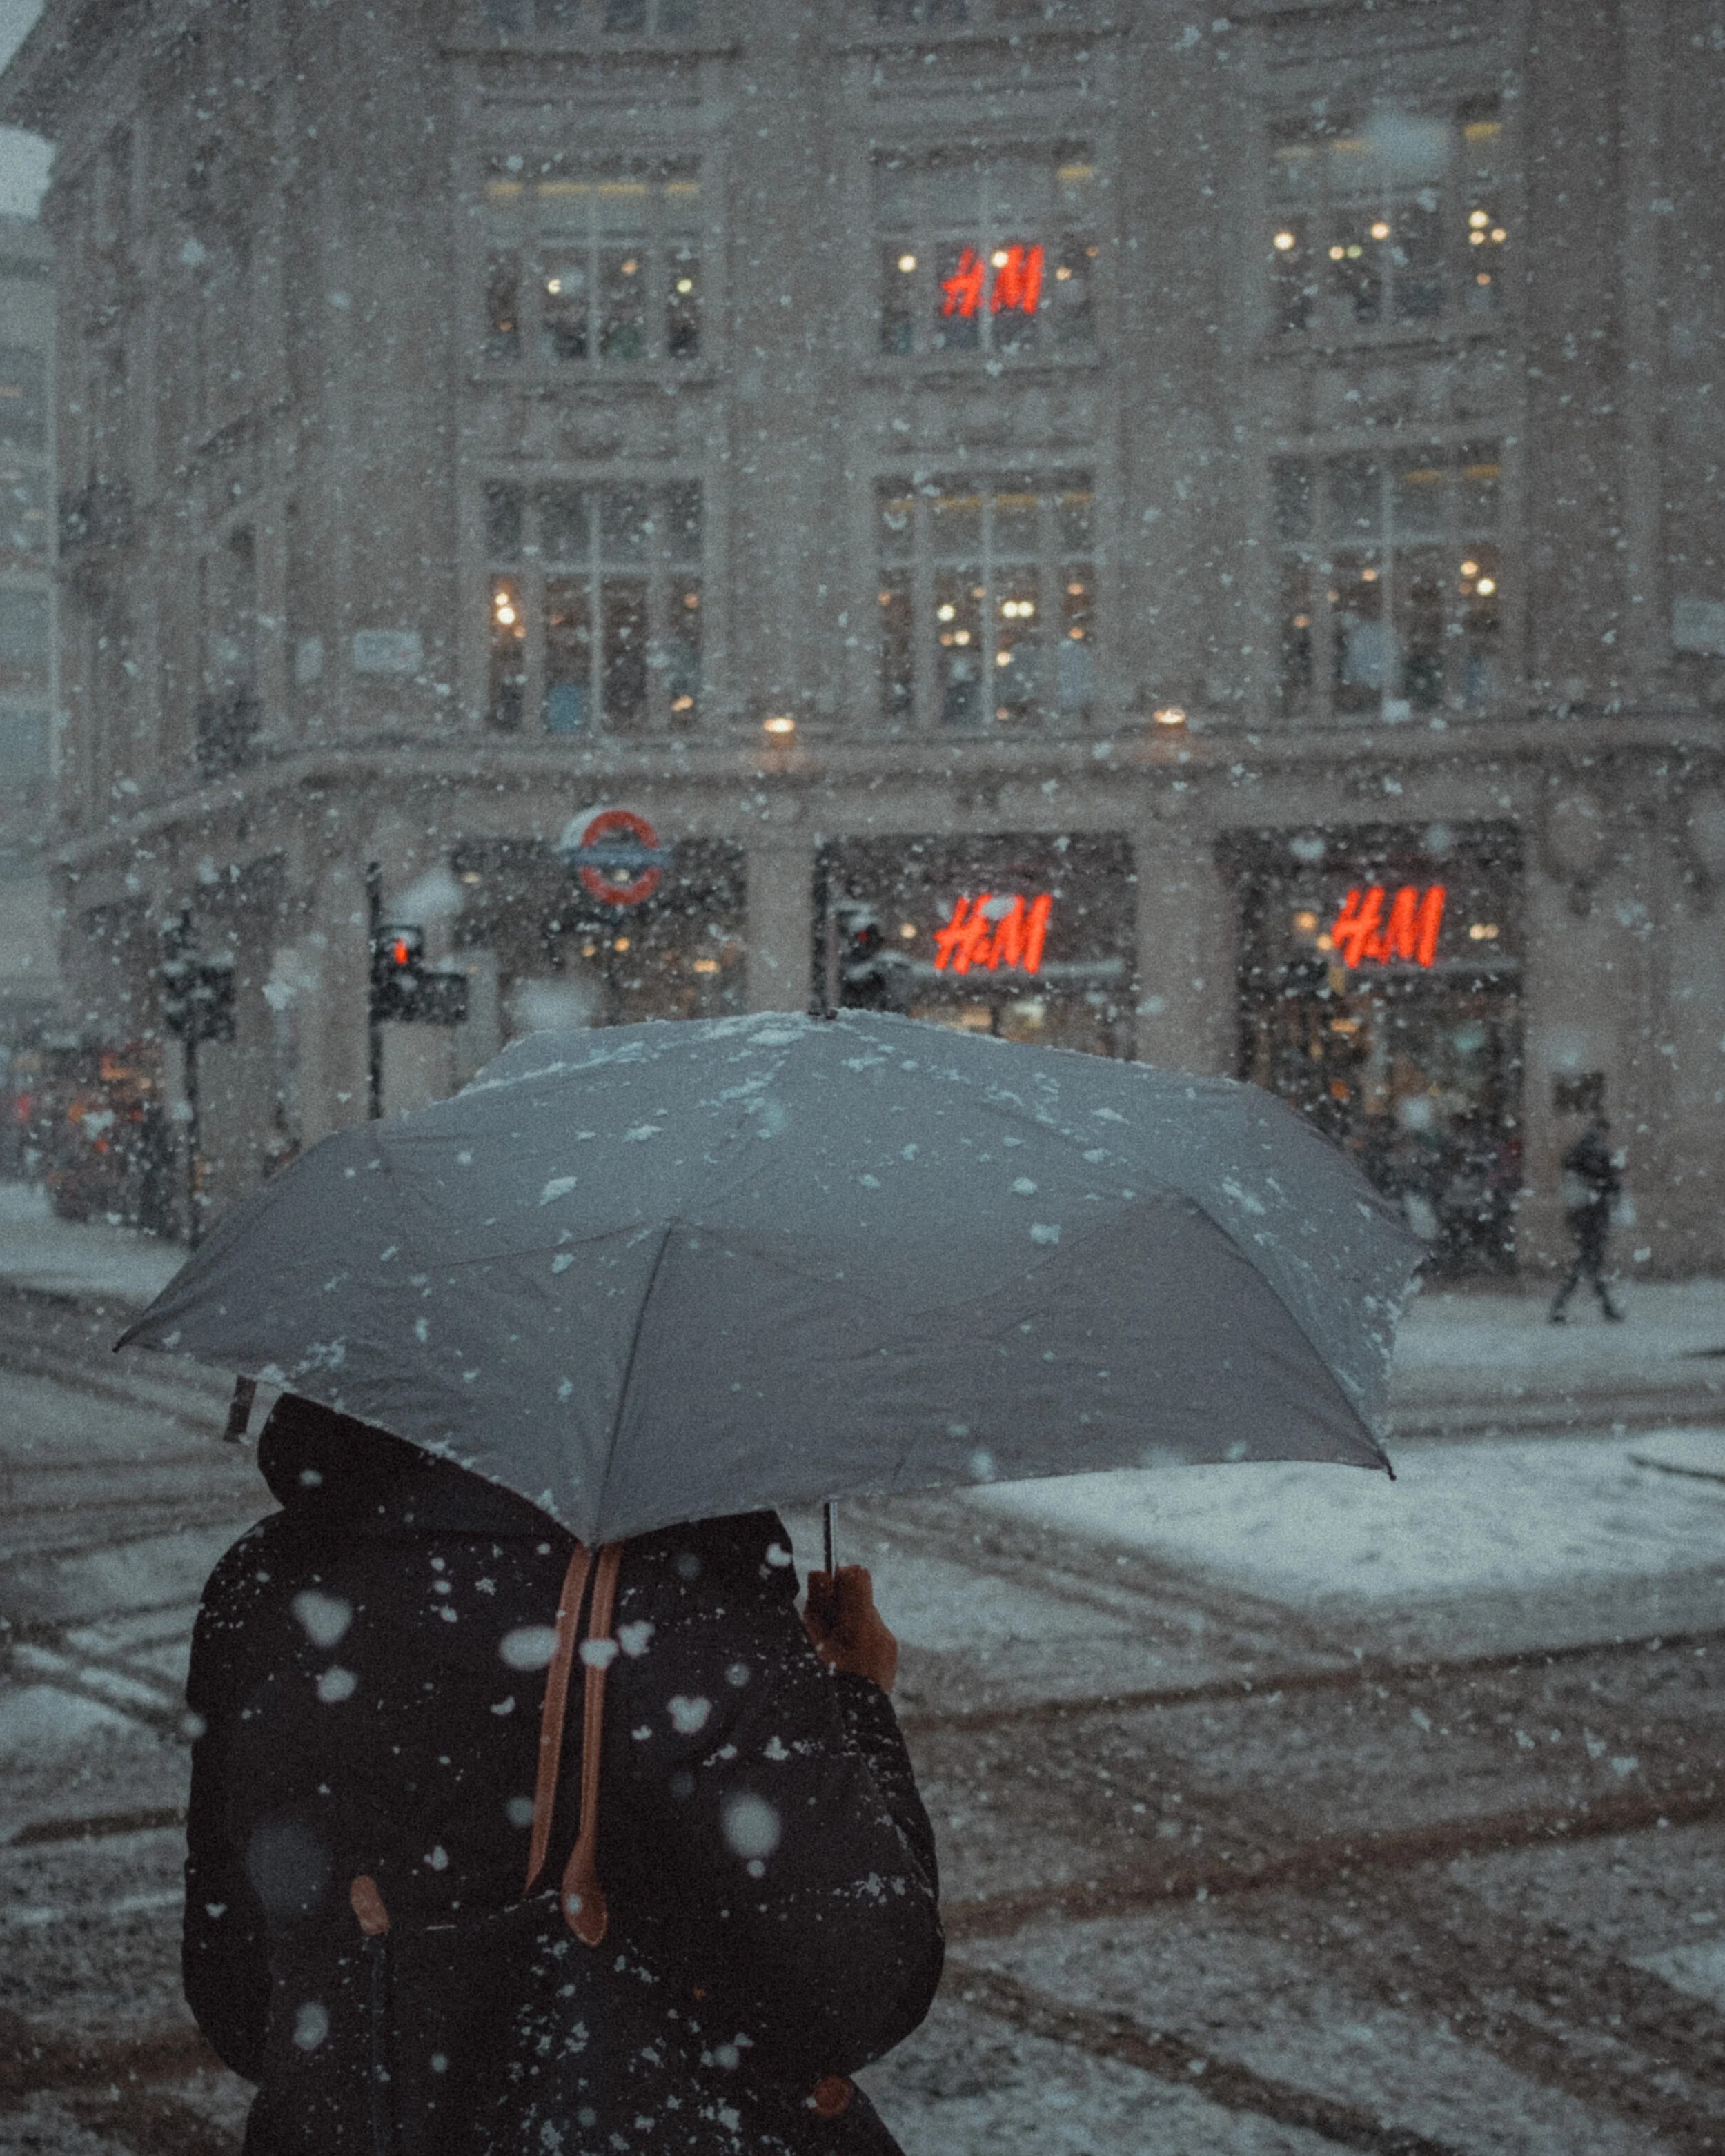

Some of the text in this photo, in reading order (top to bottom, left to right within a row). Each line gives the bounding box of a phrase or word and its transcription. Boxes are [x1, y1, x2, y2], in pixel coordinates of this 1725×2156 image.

[940, 246, 1043, 316] HM
[934, 893, 1052, 974] H&M
[1331, 886, 1446, 968] H&M
